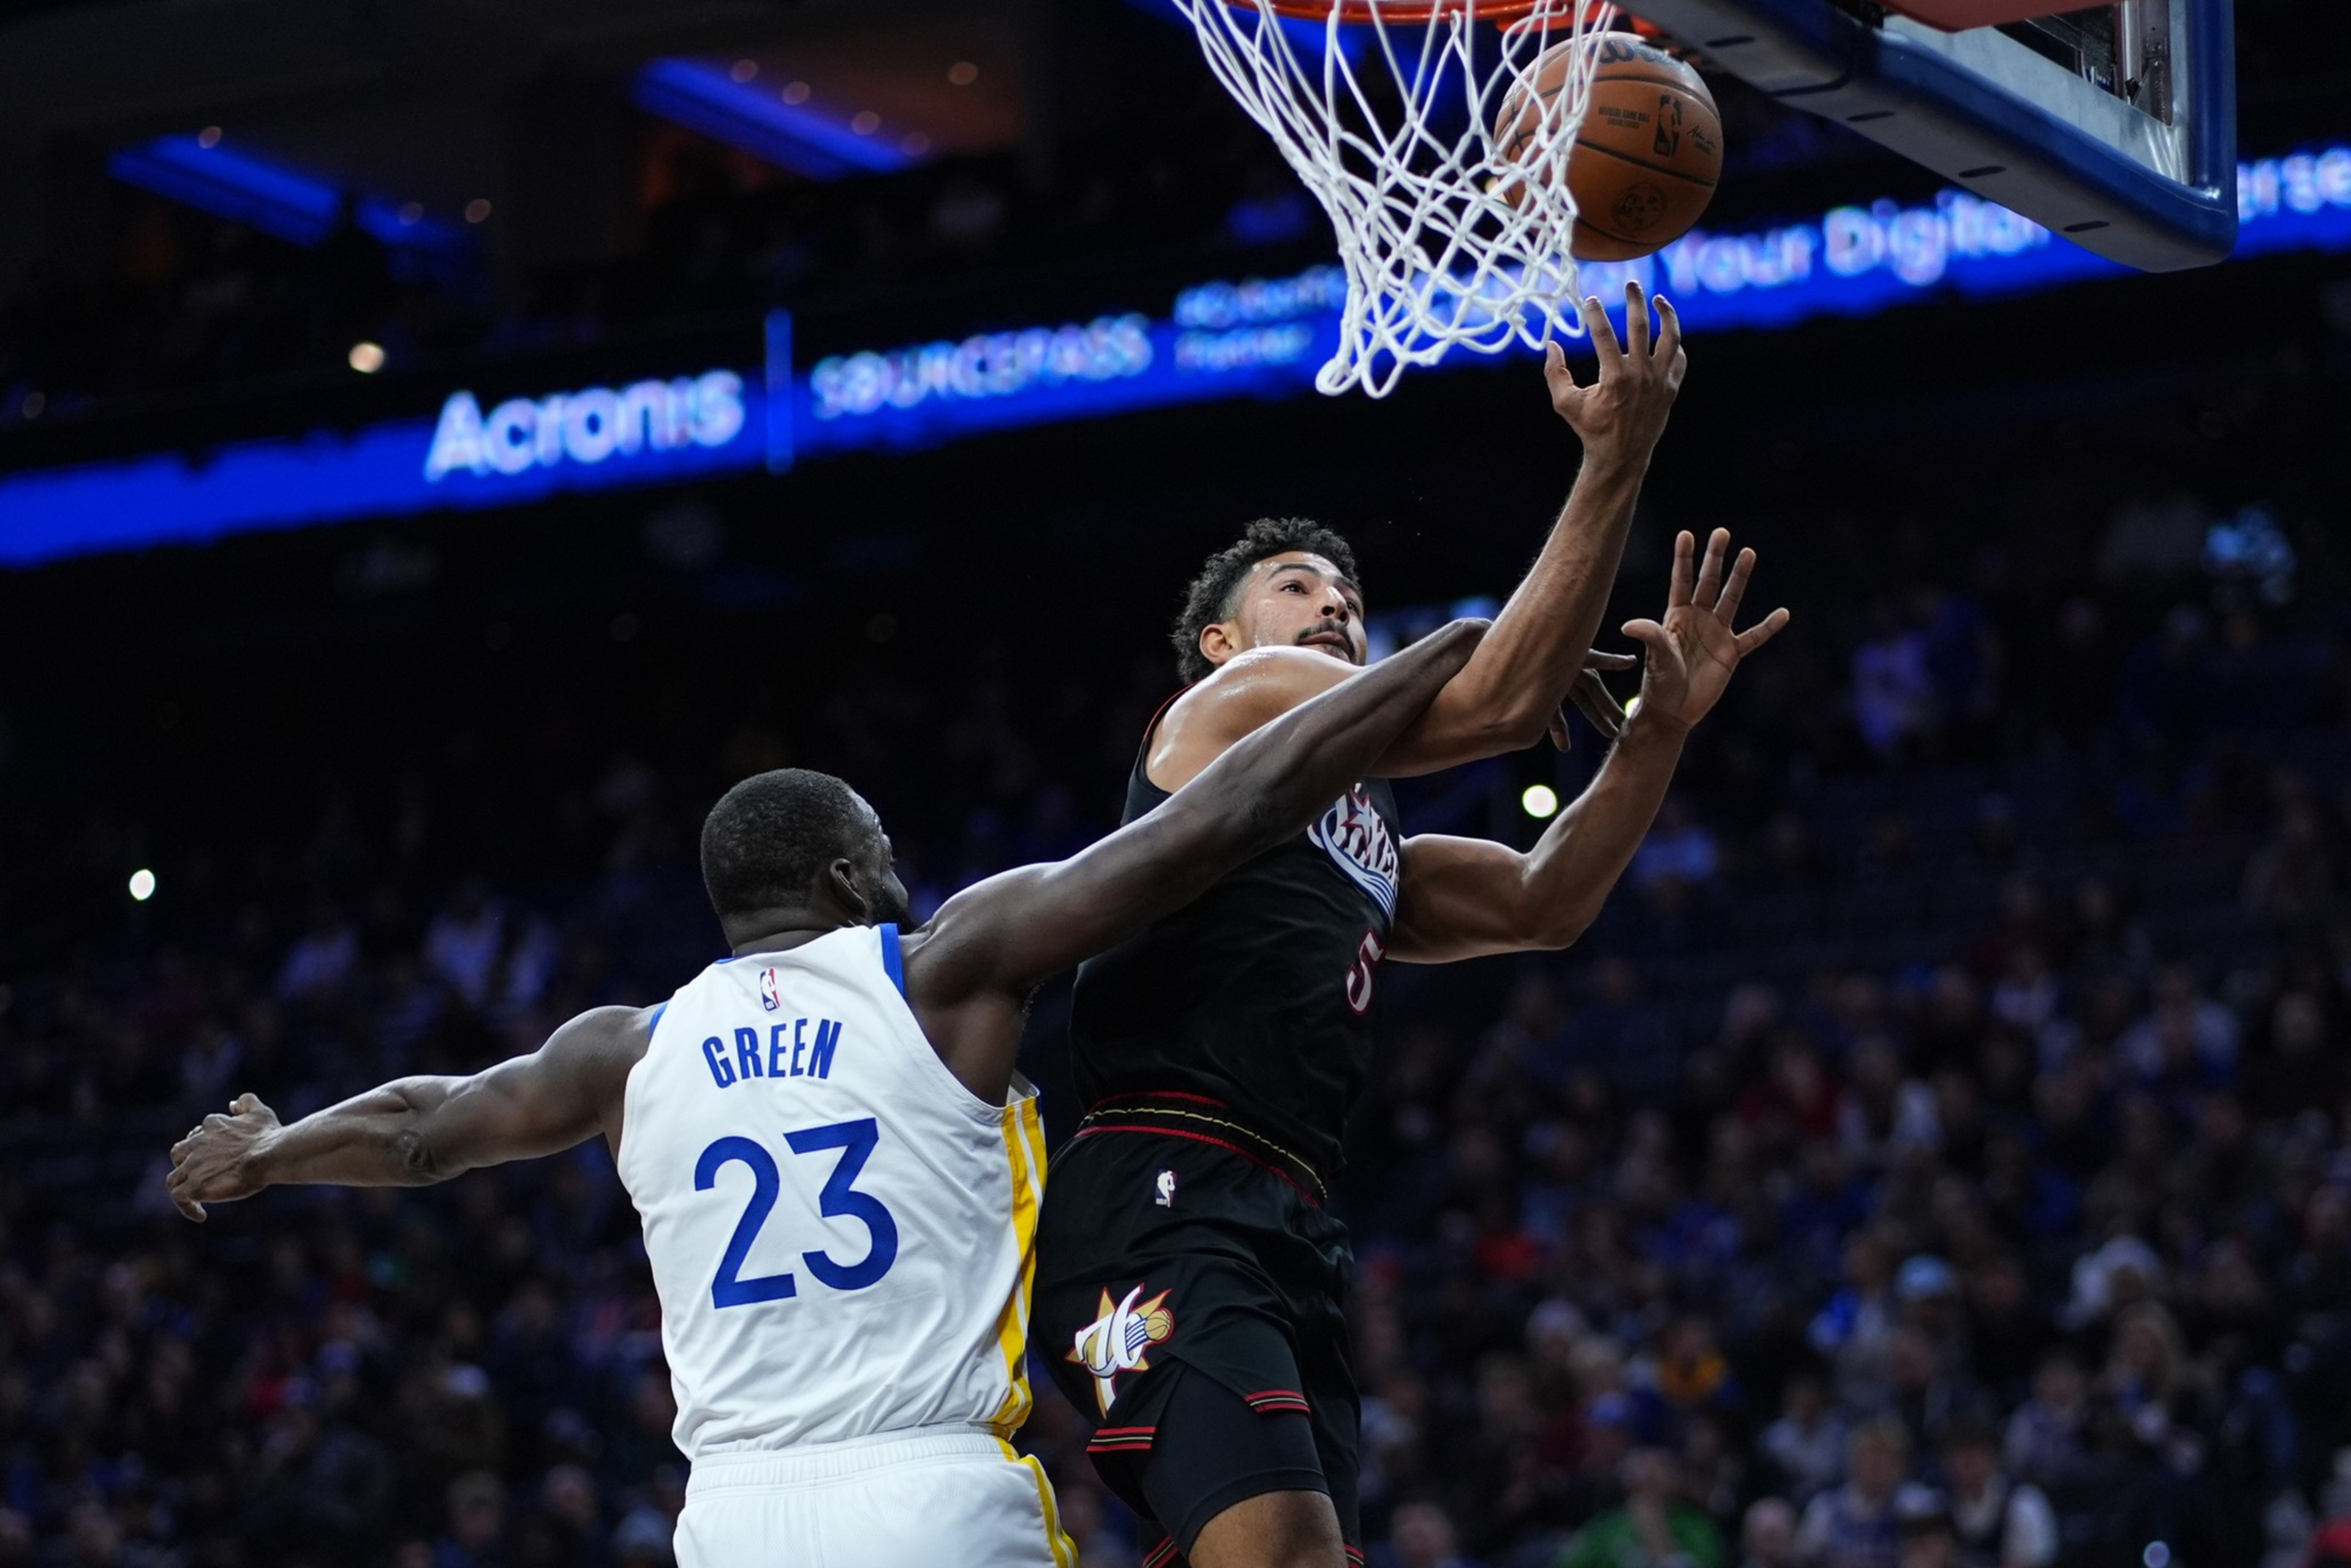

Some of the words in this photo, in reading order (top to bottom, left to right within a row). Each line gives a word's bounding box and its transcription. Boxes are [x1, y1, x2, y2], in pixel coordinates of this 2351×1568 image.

[424, 369, 745, 479] Acronis
[1346, 927, 1387, 1016] 5
[702, 1018, 842, 1088] GREEN
[694, 1117, 899, 1310] 23
